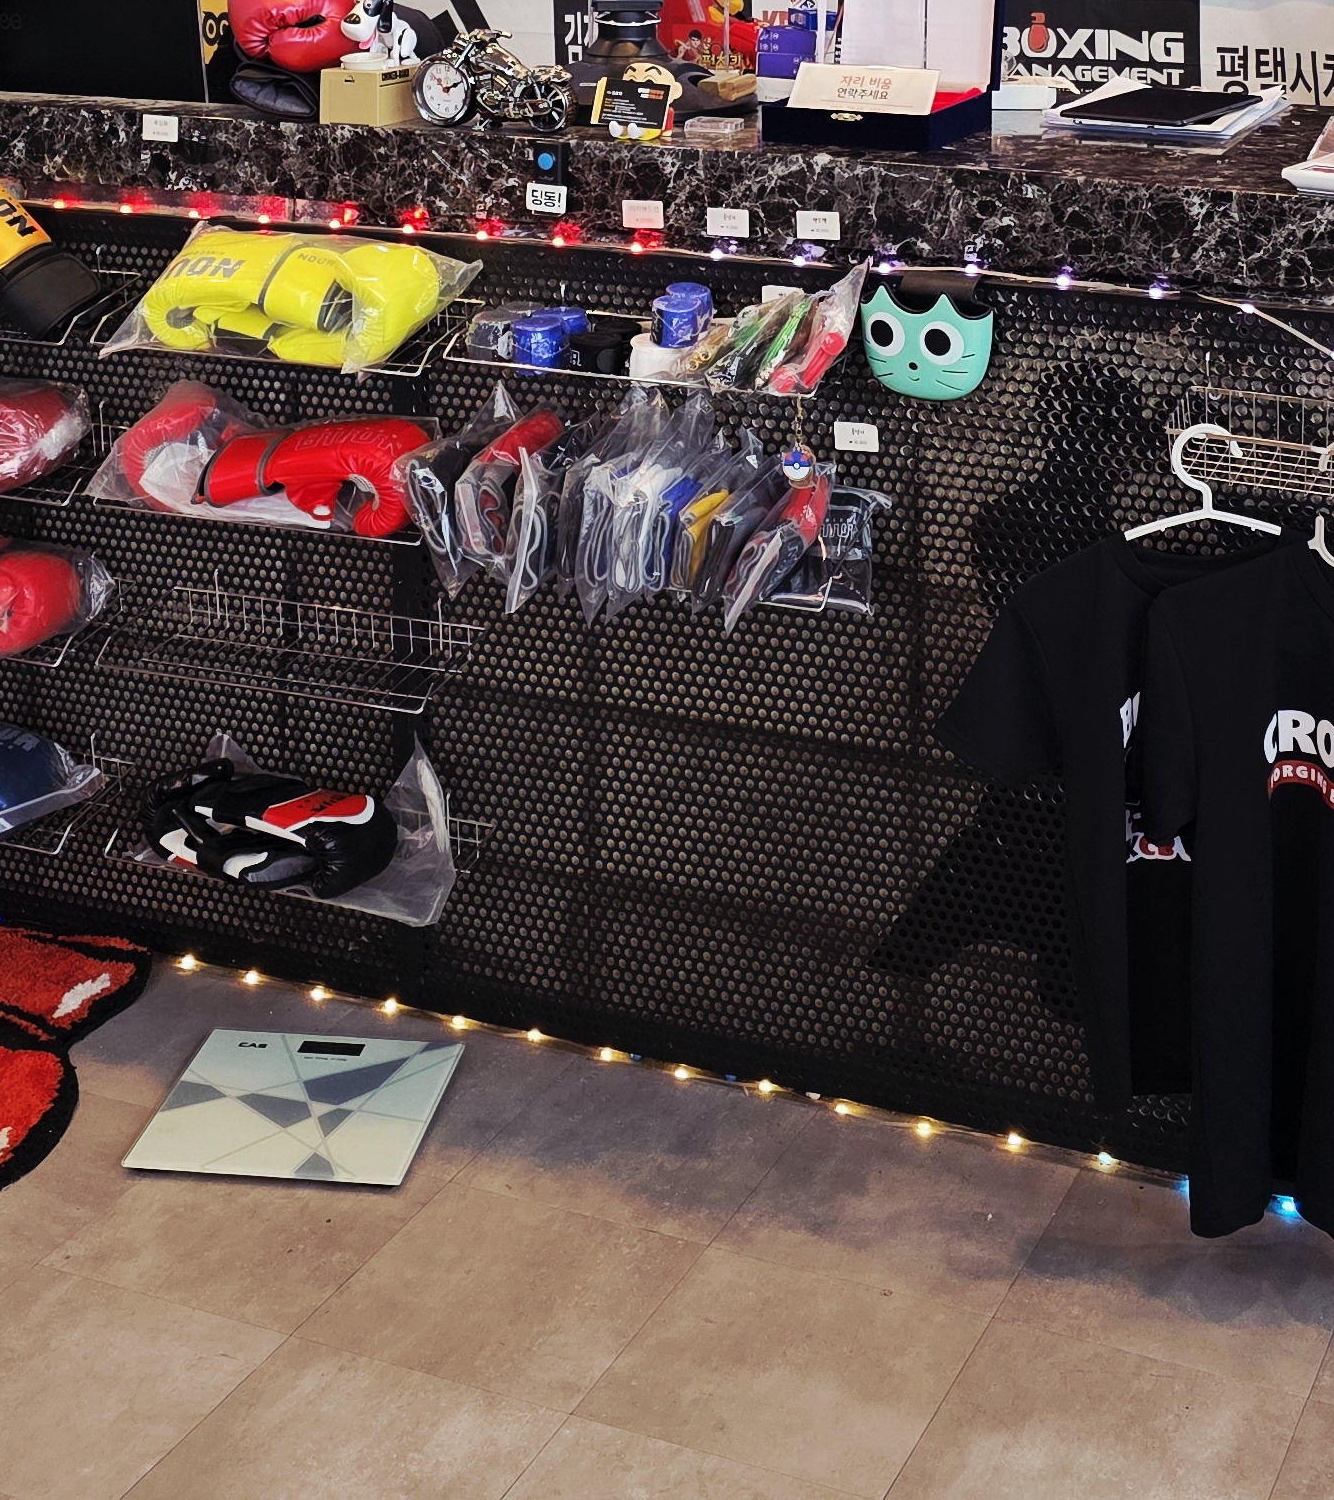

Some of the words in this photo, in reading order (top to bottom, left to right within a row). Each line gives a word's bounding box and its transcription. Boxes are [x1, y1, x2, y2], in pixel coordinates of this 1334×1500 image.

[840, 75, 866, 87] 자리
[869, 76, 893, 90] 비움
[837, 88, 889, 100] 연락주세요
[531, 189, 562, 208] 딩동!
[165, 257, 246, 280] NOU
[238, 1042, 269, 1050] CAS
